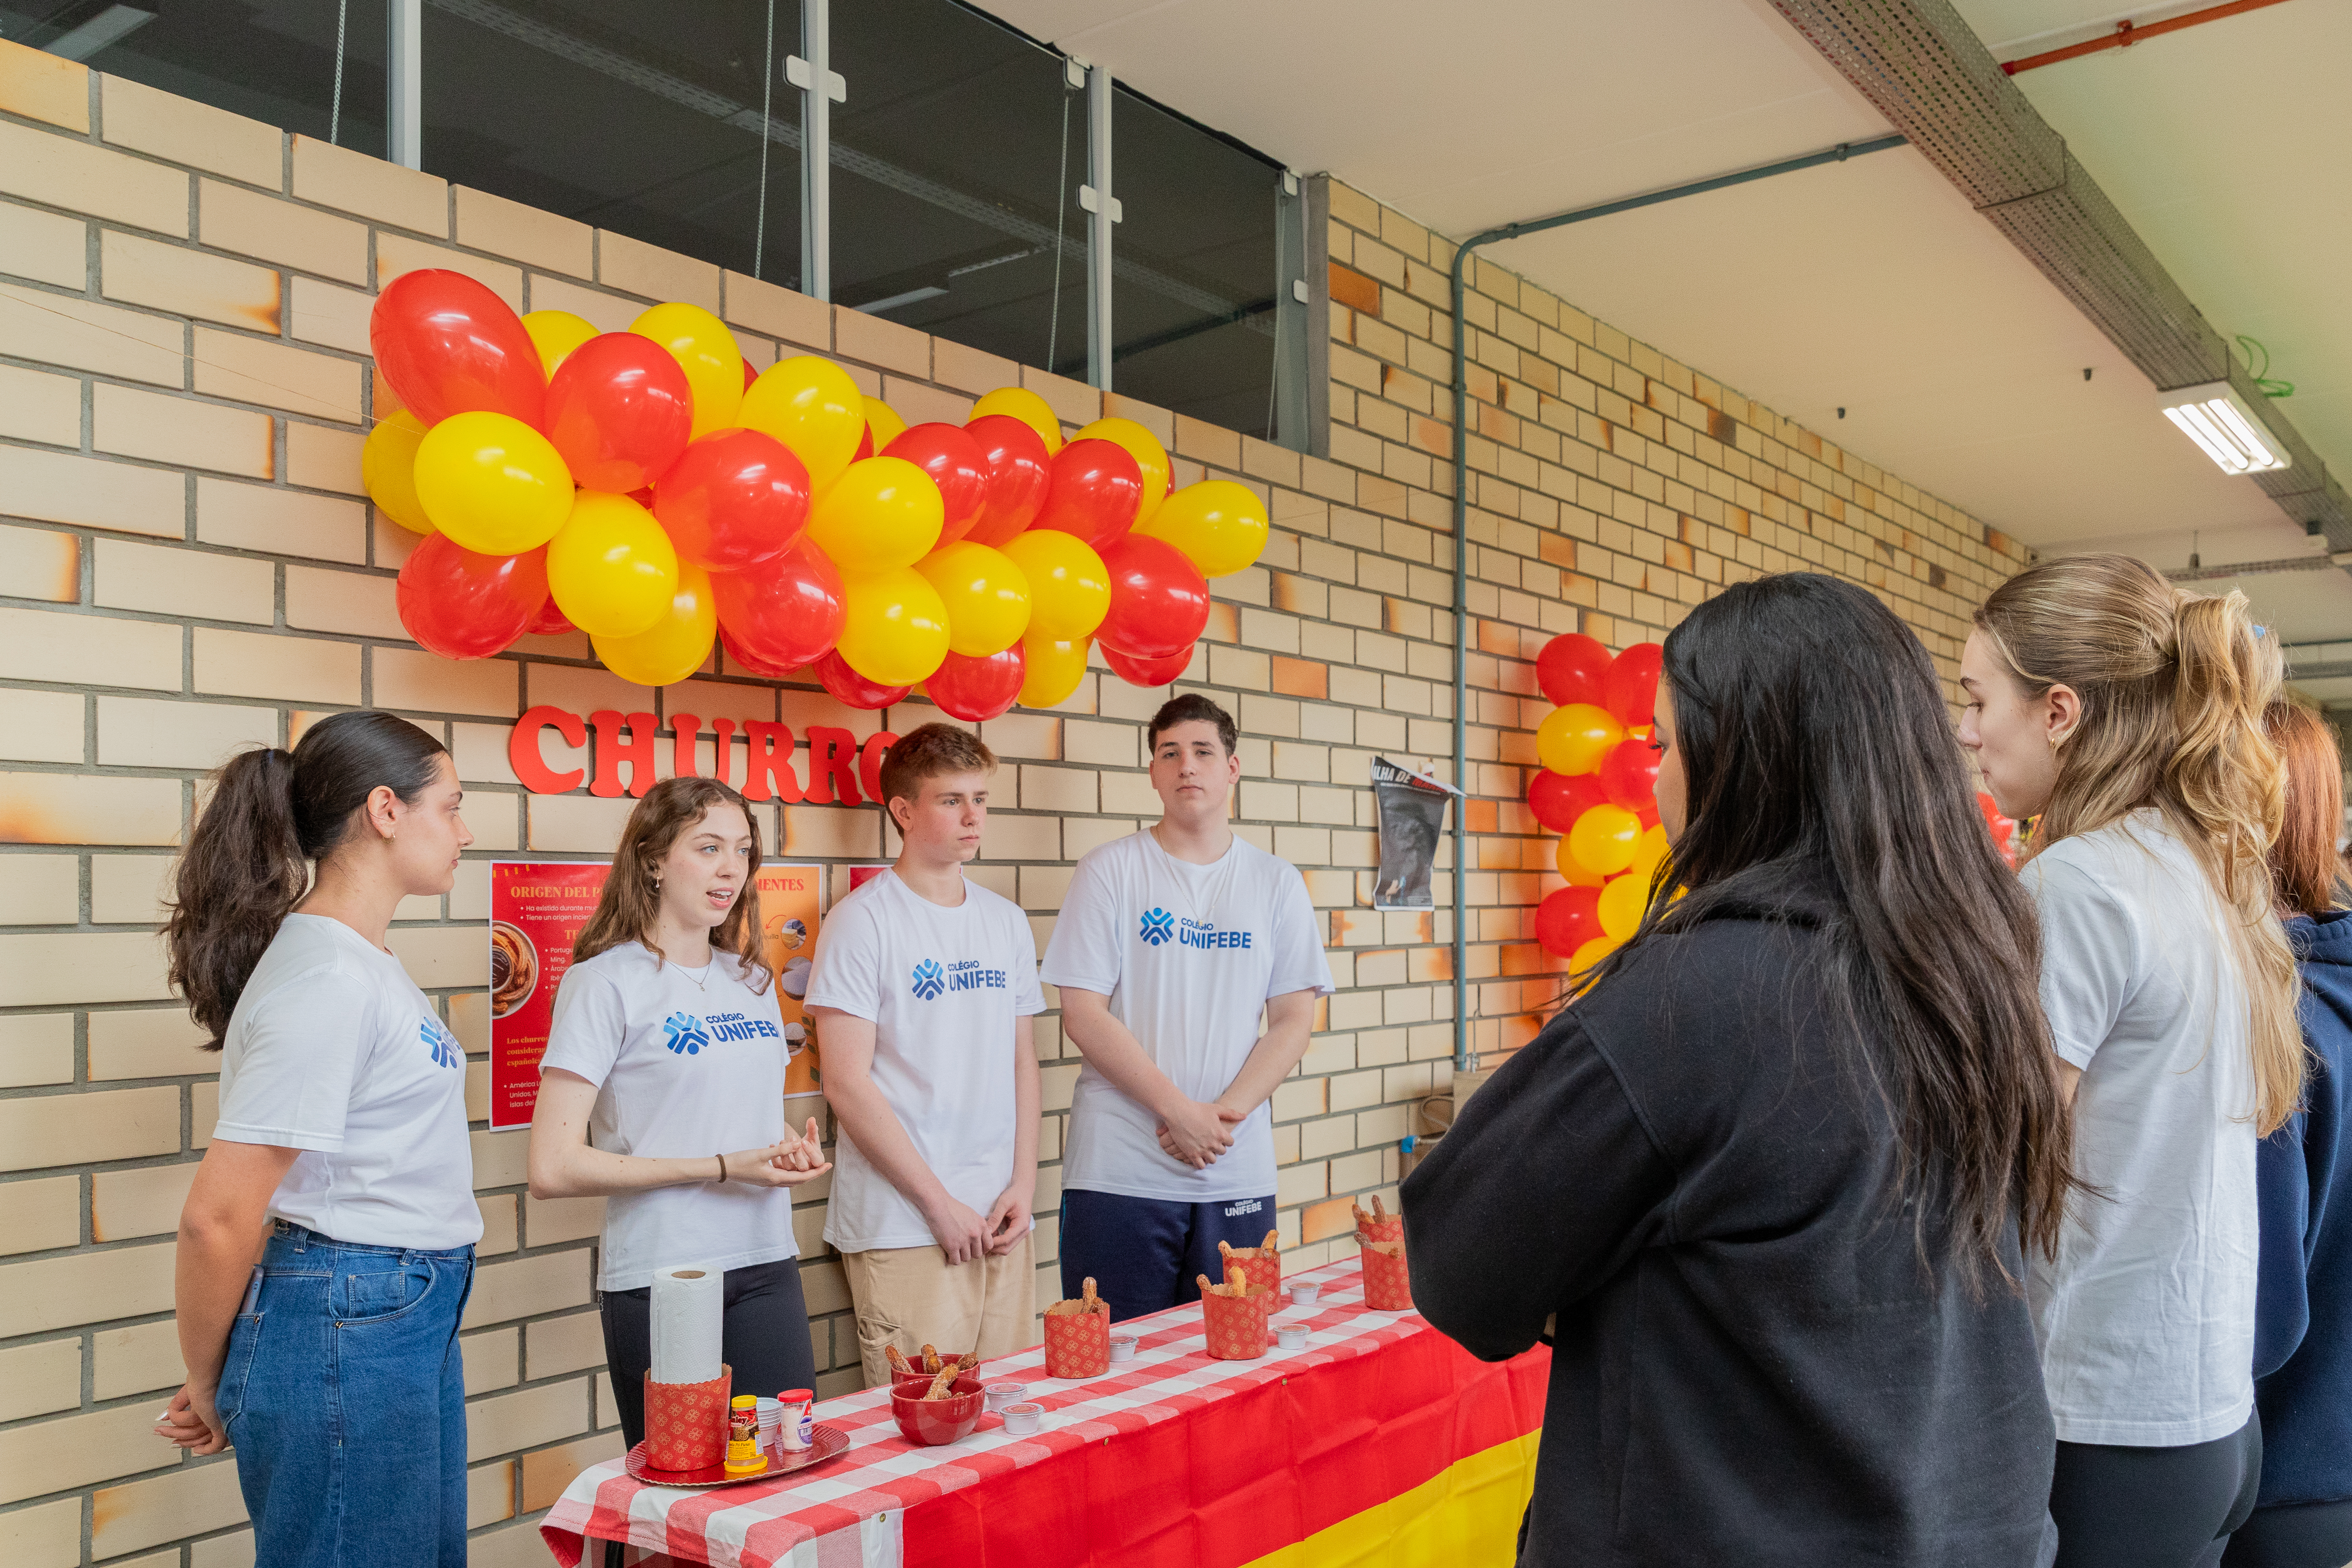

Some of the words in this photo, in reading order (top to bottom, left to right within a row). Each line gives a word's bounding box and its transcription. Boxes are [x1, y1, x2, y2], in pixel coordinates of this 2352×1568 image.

[757, 878, 804, 891] IENTES
[510, 886, 561, 898] ORIGEN
[565, 886, 590, 898] DEL
[1179, 927, 1251, 949] UNIFEBE
[948, 960, 979, 971] COLÉGIO
[949, 970, 1006, 991] UNIFEBE
[706, 1013, 745, 1024] COLÉGIO
[711, 1020, 779, 1042] UNIFEB
[1225, 1201, 1262, 1217] UNIFEBE
